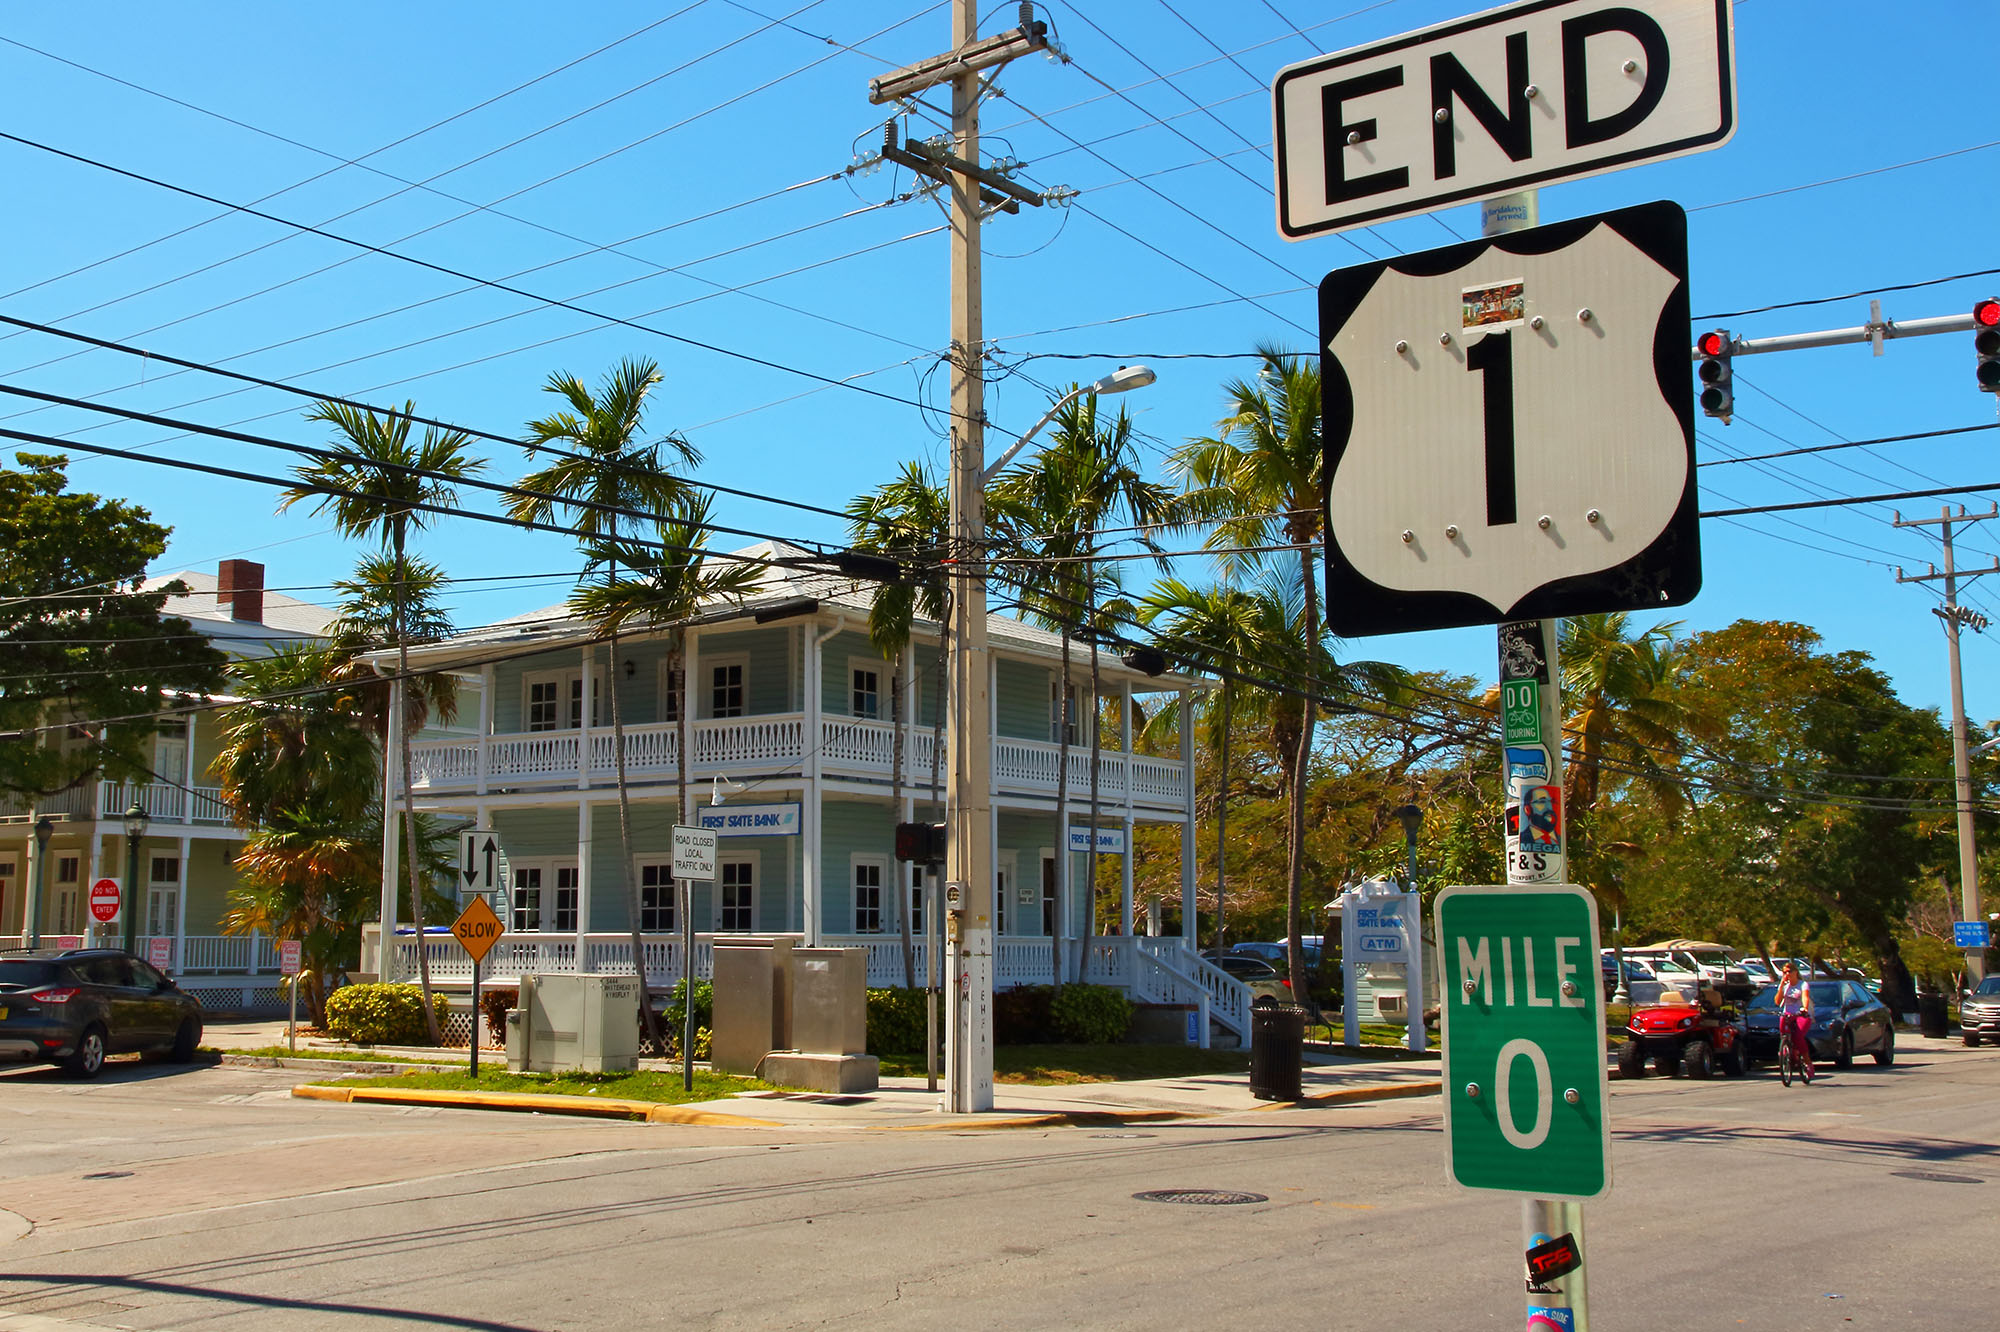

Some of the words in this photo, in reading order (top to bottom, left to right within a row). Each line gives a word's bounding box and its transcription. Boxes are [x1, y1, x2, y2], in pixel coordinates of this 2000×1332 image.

[1321, 7, 1670, 206] END
[1466, 329, 1517, 527] 1
[1507, 727, 1536, 739] TOURING
[701, 815, 726, 829] FIRST
[728, 814, 753, 828] STATE
[754, 813, 781, 827] BANK
[675, 835, 691, 846] ROAD
[692, 836, 715, 848] CLOSED
[1085, 834, 1099, 846] STE
[684, 848, 703, 859] LOCAL
[1520, 842, 1561, 853] MEGA
[675, 860, 698, 871] TRAFFIC
[700, 862, 714, 872] ONLY
[95, 906, 114, 914] ENTER
[1357, 909, 1378, 918] FIRST
[1357, 918, 1379, 928] STATE
[1381, 918, 1403, 929] BANK
[459, 922, 496, 938] SLOW
[1367, 939, 1396, 949] ATM
[1457, 935, 1586, 1008] MILE
[1494, 1038, 1553, 1150] 0
